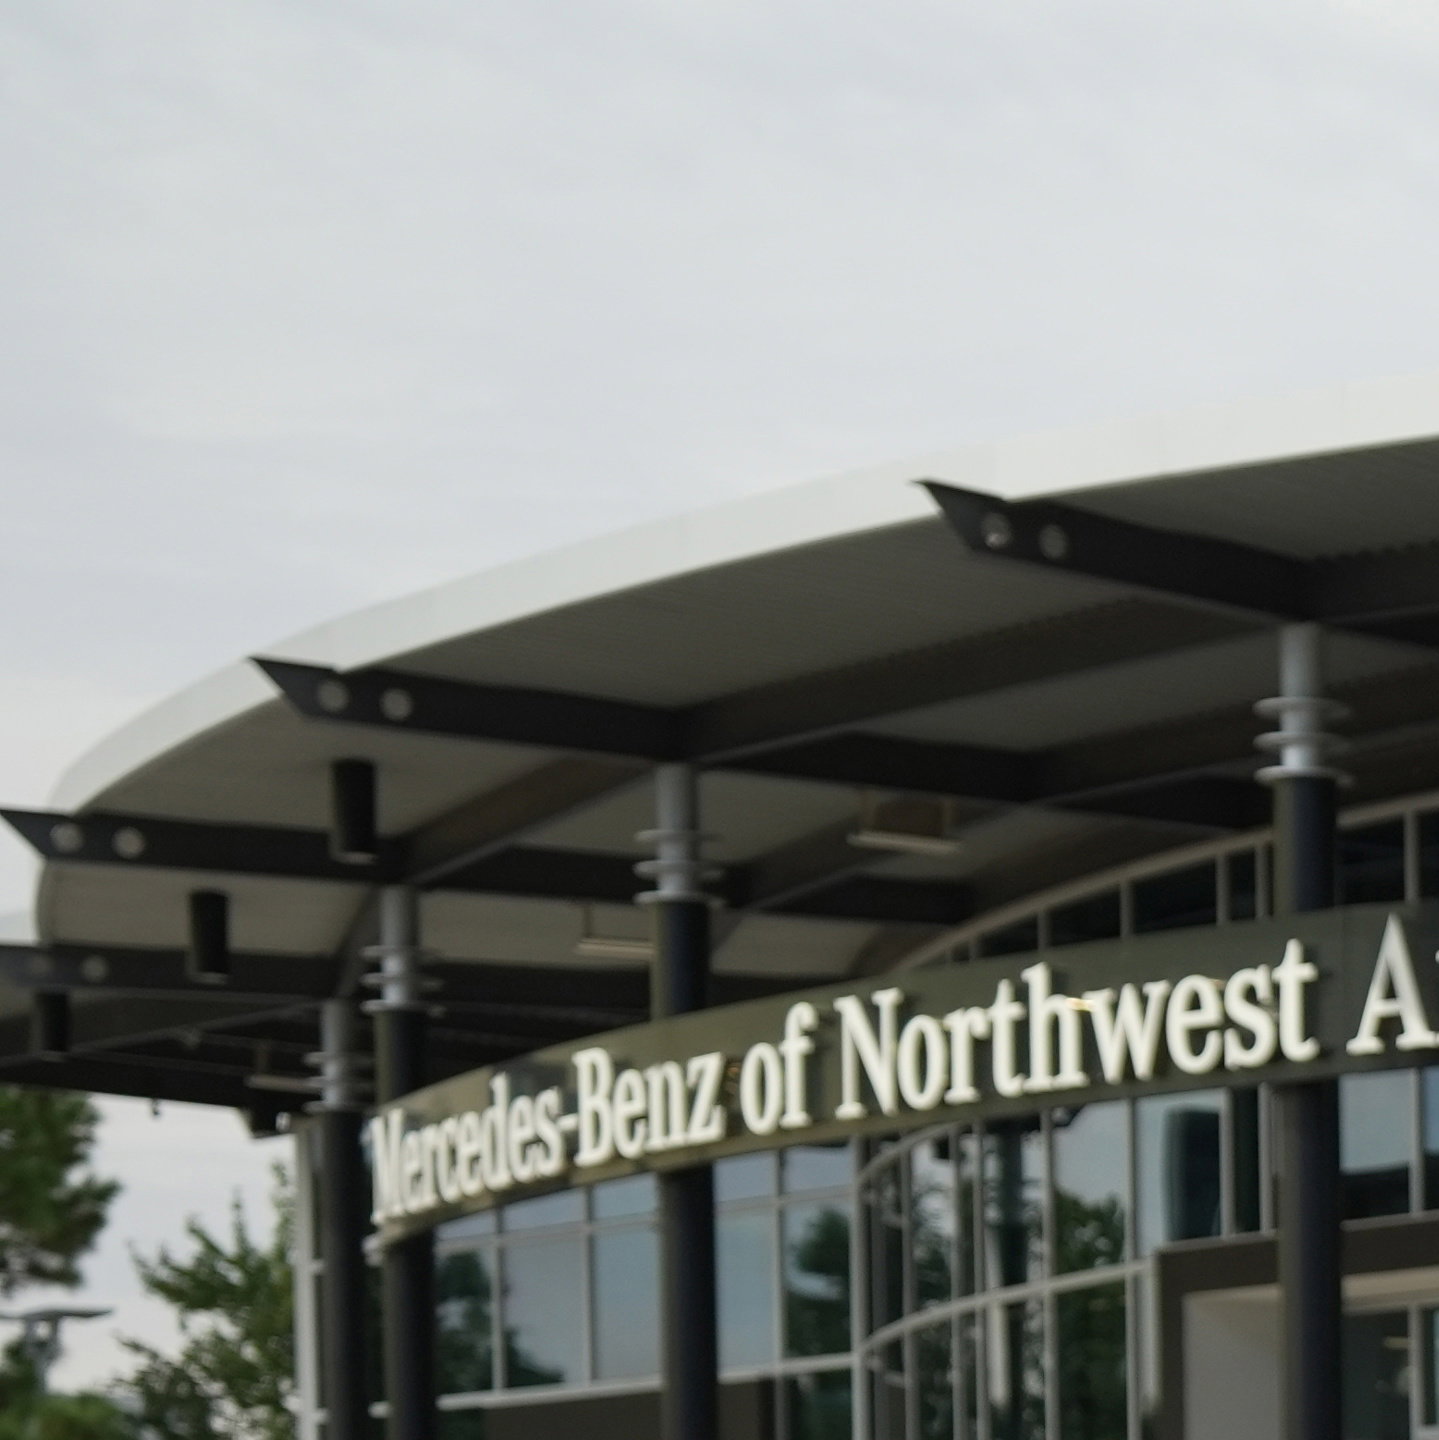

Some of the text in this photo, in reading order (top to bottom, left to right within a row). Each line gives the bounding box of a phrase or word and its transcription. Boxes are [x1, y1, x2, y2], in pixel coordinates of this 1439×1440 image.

[369, 1047, 726, 1226] Mercedes-Benz
[740, 1001, 818, 1136] of
[833, 938, 1321, 1121] Northwest
